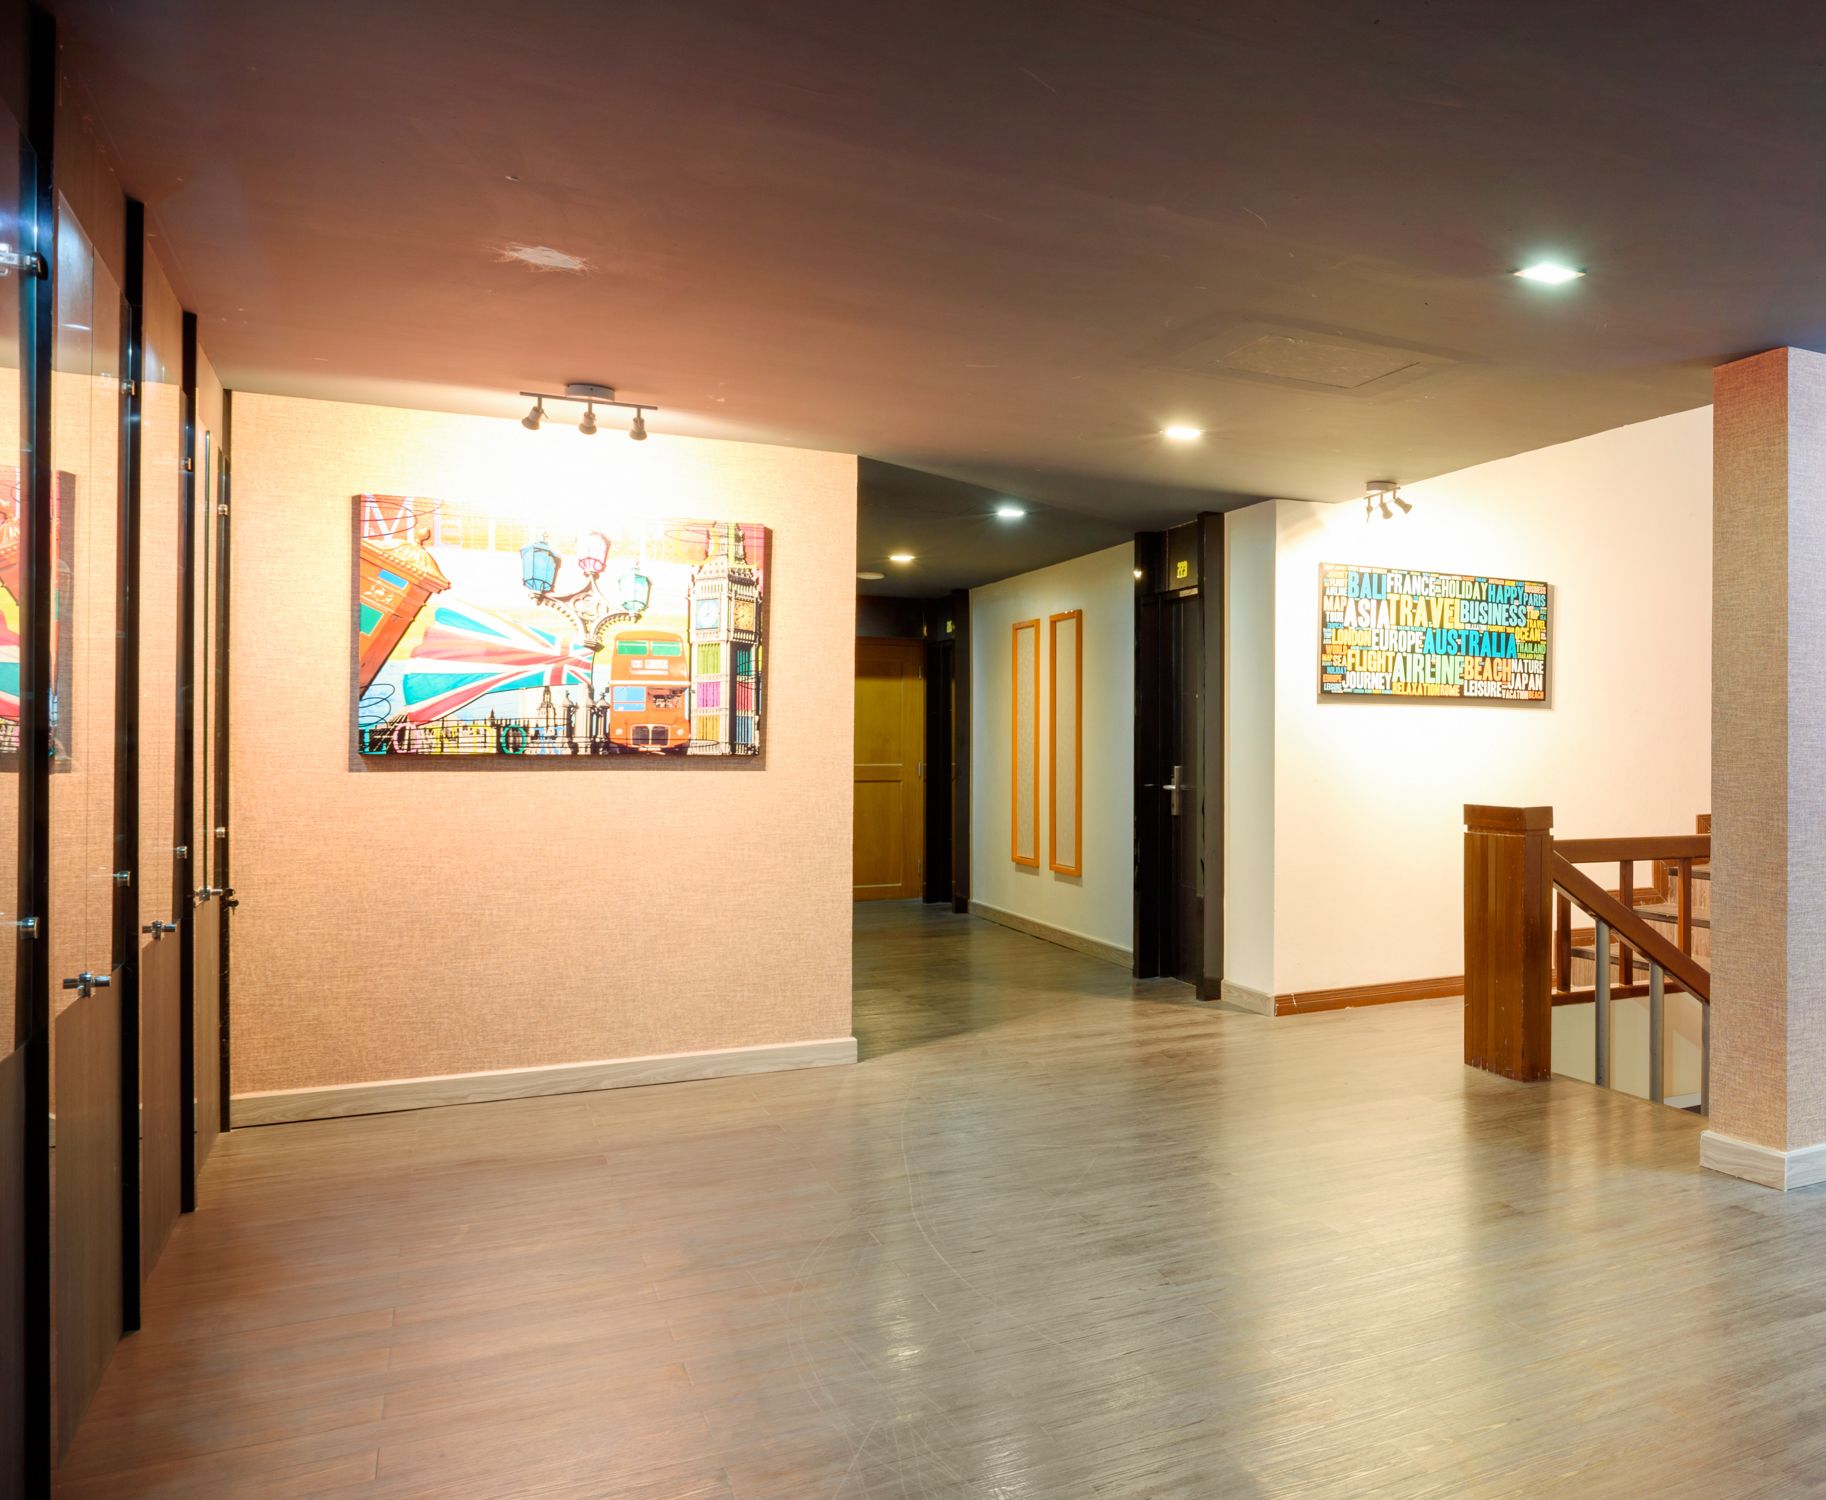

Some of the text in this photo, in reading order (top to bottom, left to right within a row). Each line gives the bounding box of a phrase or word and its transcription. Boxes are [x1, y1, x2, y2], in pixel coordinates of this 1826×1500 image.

[1347, 571, 1387, 600] BALI
[1386, 573, 1437, 597] FRANCE
[1441, 579, 1488, 600] HOLIDAY
[1323, 595, 1347, 611] MAP
[1488, 583, 1524, 606] HAPPY
[1523, 593, 1546, 607] PARIS
[1325, 611, 1344, 622] TOUR
[1344, 598, 1390, 629] ASIA
[1386, 591, 1465, 630] TRAVEL
[1460, 600, 1526, 627] BUSINESS
[1526, 619, 1546, 629] TRAVEL
[1331, 628, 1372, 646] LONDON
[1372, 629, 1424, 653] EUROPE
[1514, 626, 1541, 641] OCEAN
[1325, 644, 1348, 655] WORLD
[1423, 627, 1518, 659] AUSTRALIA
[1515, 642, 1547, 655] THAILAND
[1332, 655, 1347, 667] SEA
[1347, 649, 1395, 673] FLIGHT
[1391, 652, 1465, 686] AIRLINE
[1463, 655, 1512, 683] BEACH
[1511, 658, 1544, 674] NATURE
[1342, 670, 1393, 690] JOURNEY
[1391, 681, 1440, 697] RELAXATION
[1463, 680, 1502, 697] LEISURE
[1507, 672, 1544, 691] JAPAN
[1440, 683, 1461, 697] ROME
[1502, 689, 1528, 700] VACATION
[1528, 690, 1545, 700] BEACH
